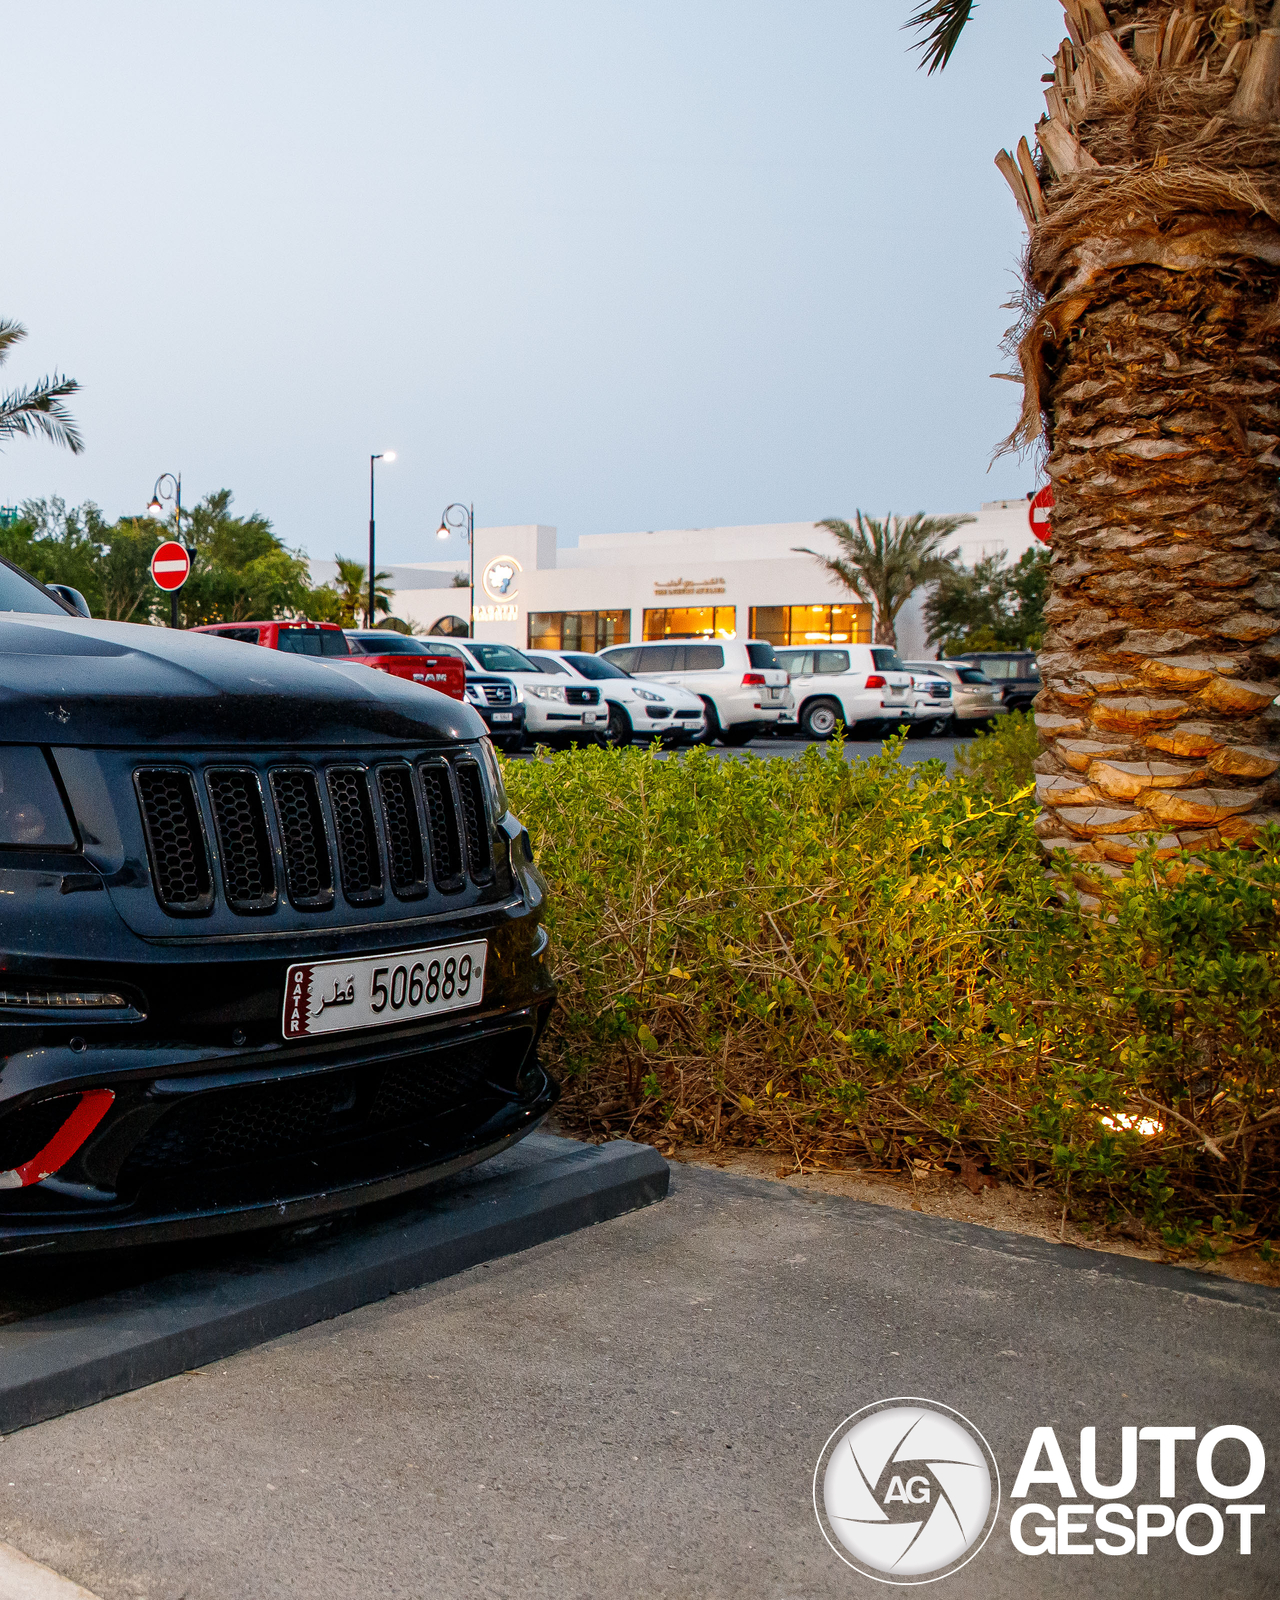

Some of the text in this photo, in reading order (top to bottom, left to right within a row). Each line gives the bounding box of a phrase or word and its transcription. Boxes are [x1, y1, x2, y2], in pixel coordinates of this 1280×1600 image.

[412, 673, 447, 682] RAM
[290, 971, 304, 1032] QATAR
[310, 974, 356, 1018] قطر
[370, 953, 473, 1014] 506889
